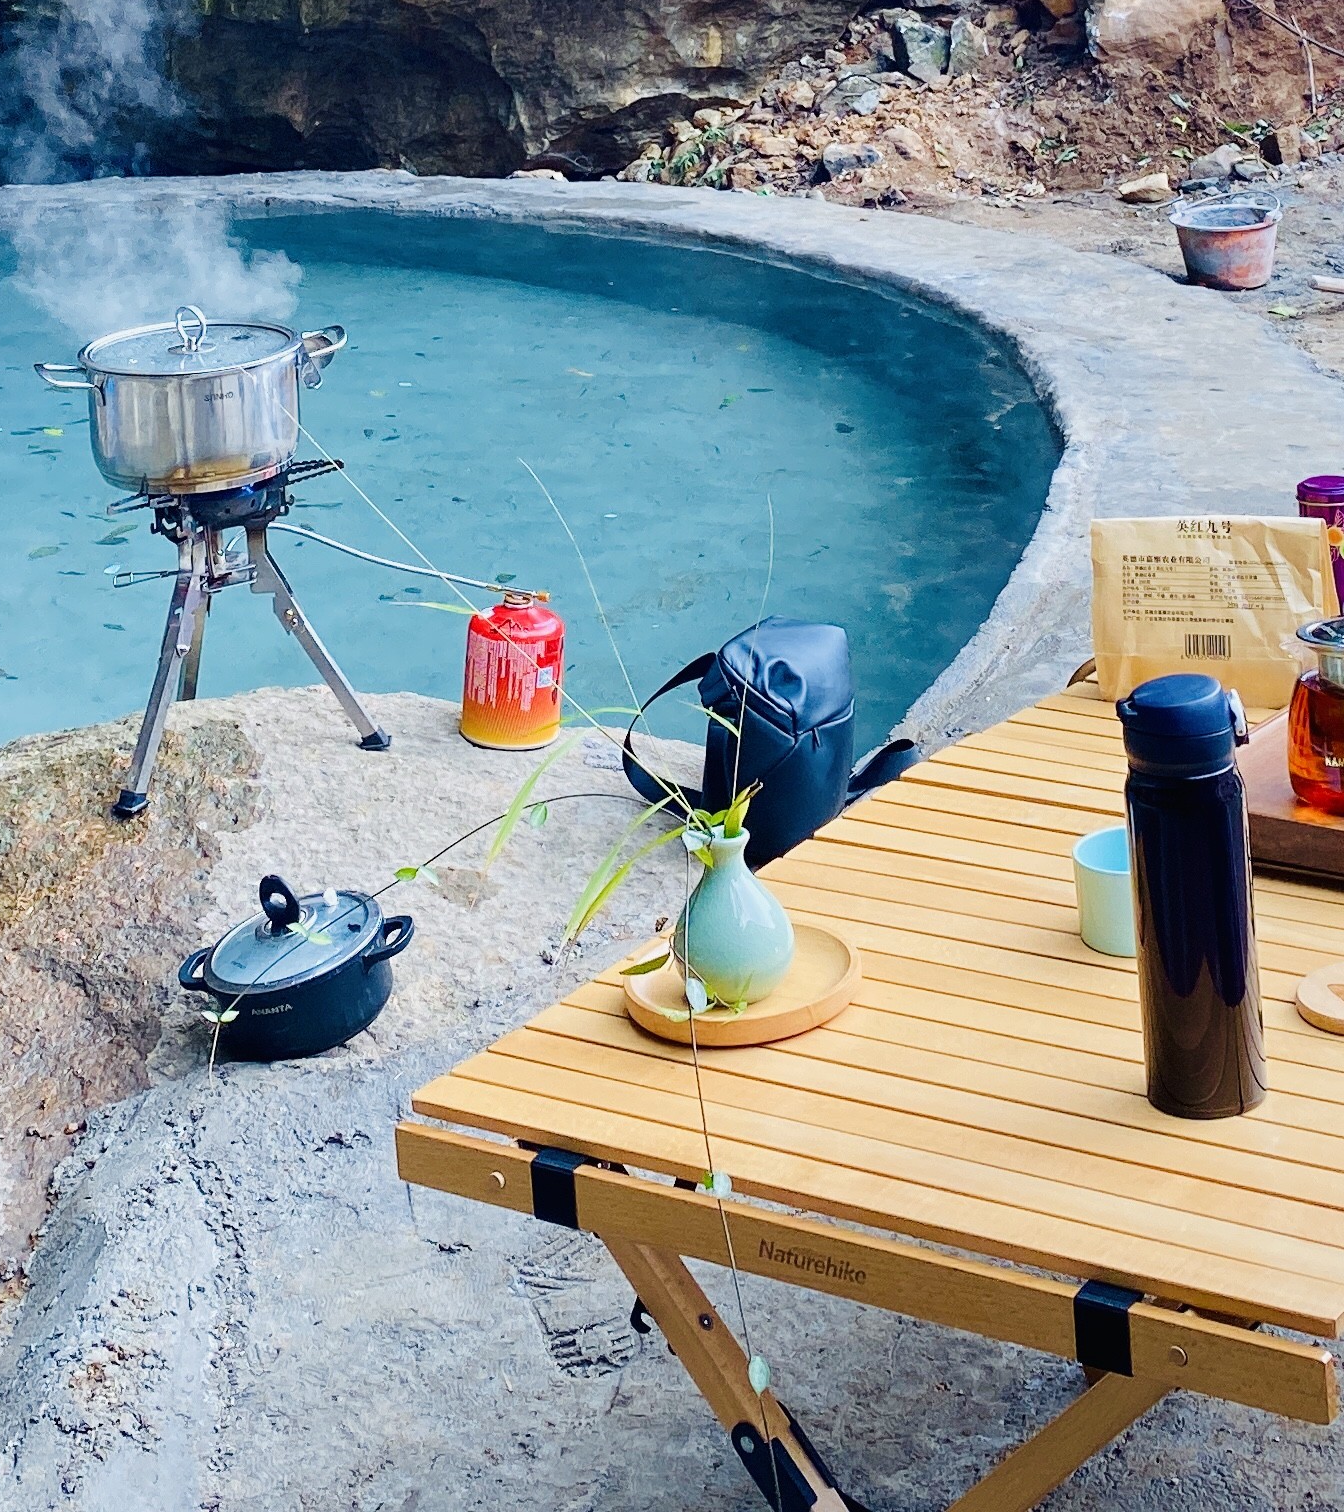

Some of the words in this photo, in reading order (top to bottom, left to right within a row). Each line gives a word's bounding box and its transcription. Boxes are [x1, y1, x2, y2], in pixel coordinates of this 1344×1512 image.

[1176, 520, 1232, 533] 英红九号
[758, 1238, 867, 1285] Naturehike
